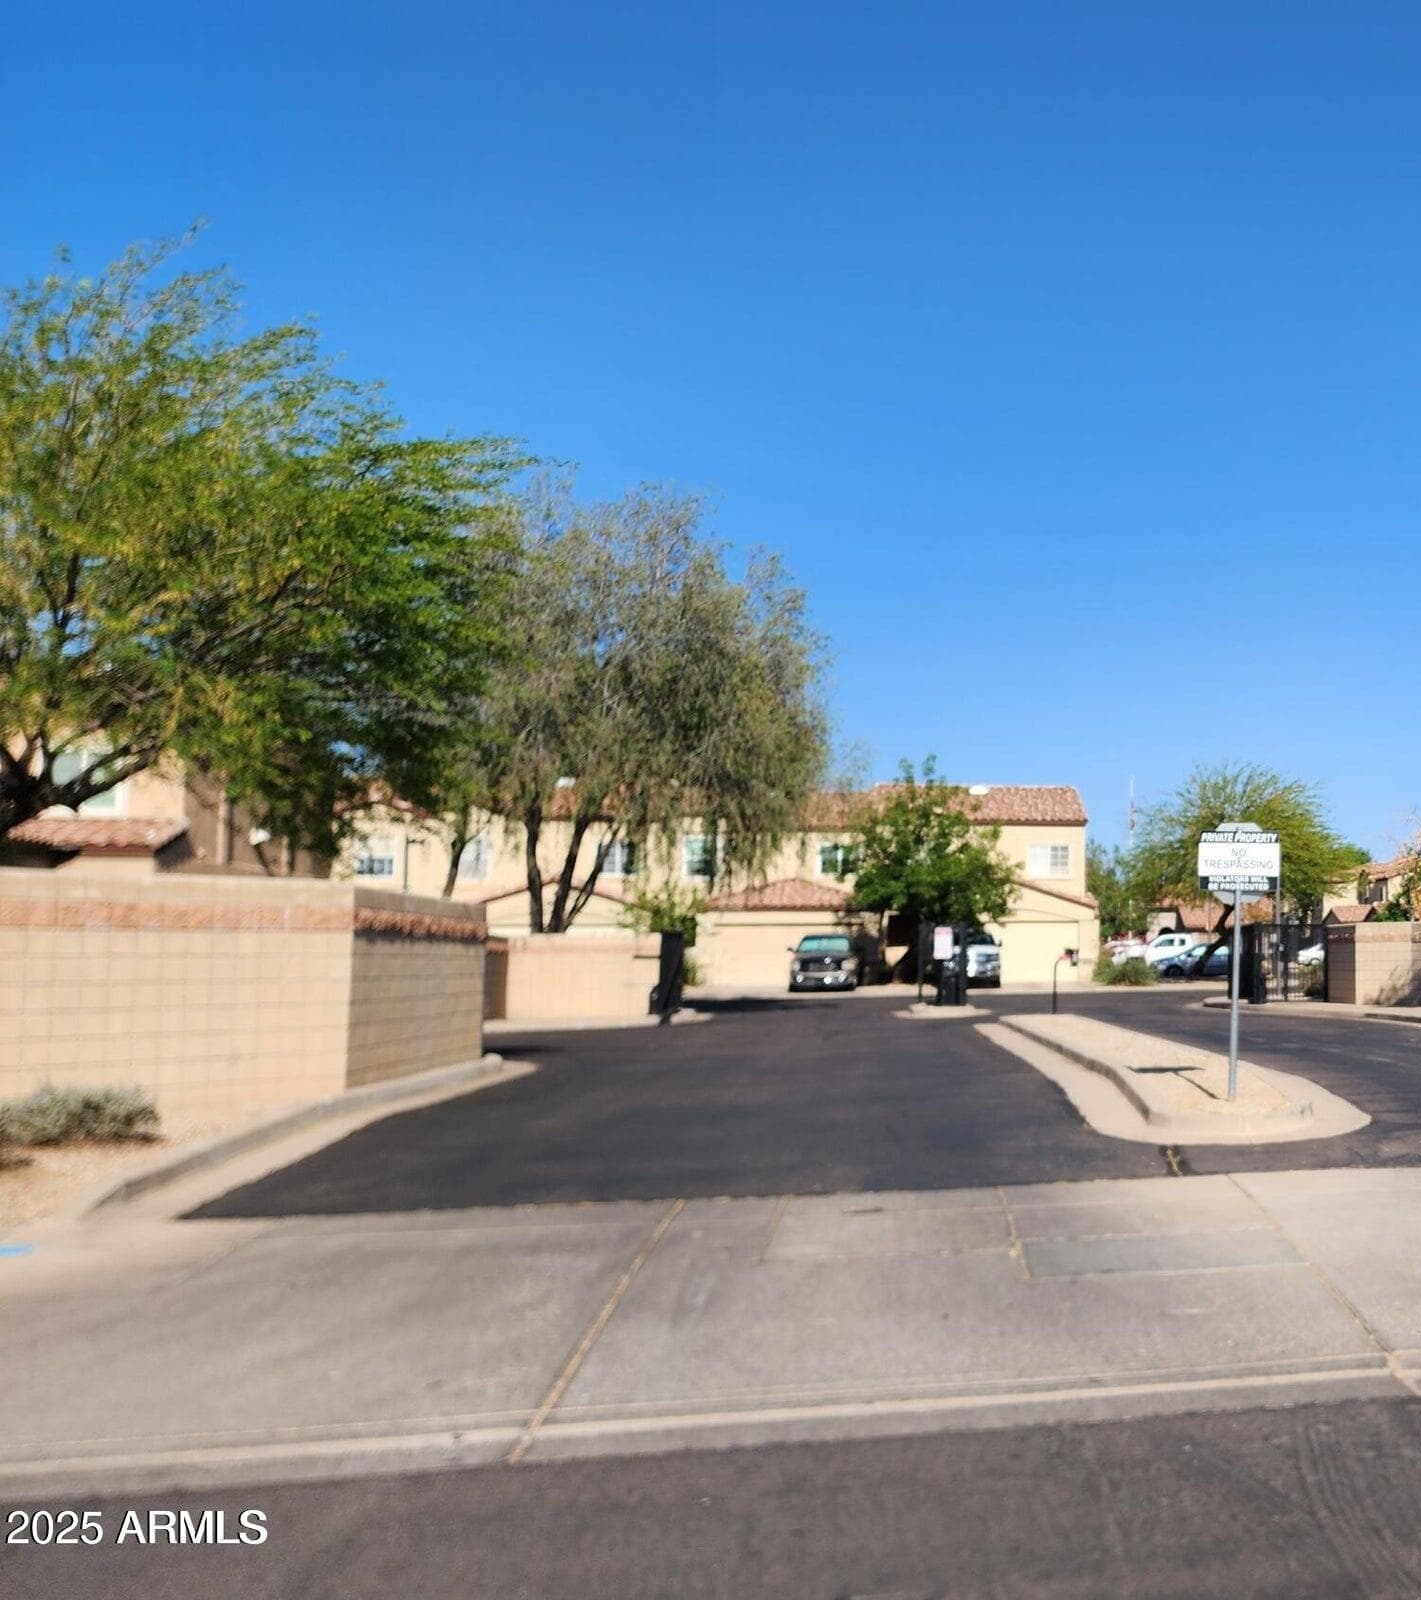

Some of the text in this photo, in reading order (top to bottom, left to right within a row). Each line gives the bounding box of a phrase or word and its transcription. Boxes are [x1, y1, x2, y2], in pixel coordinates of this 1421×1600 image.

[1201, 832, 1277, 842] PRIVATE PROPERTY
[1232, 848, 1247, 857] NO
[1204, 860, 1274, 869] TRESPASSING
[1208, 883, 1270, 891] BE PROSECUTED
